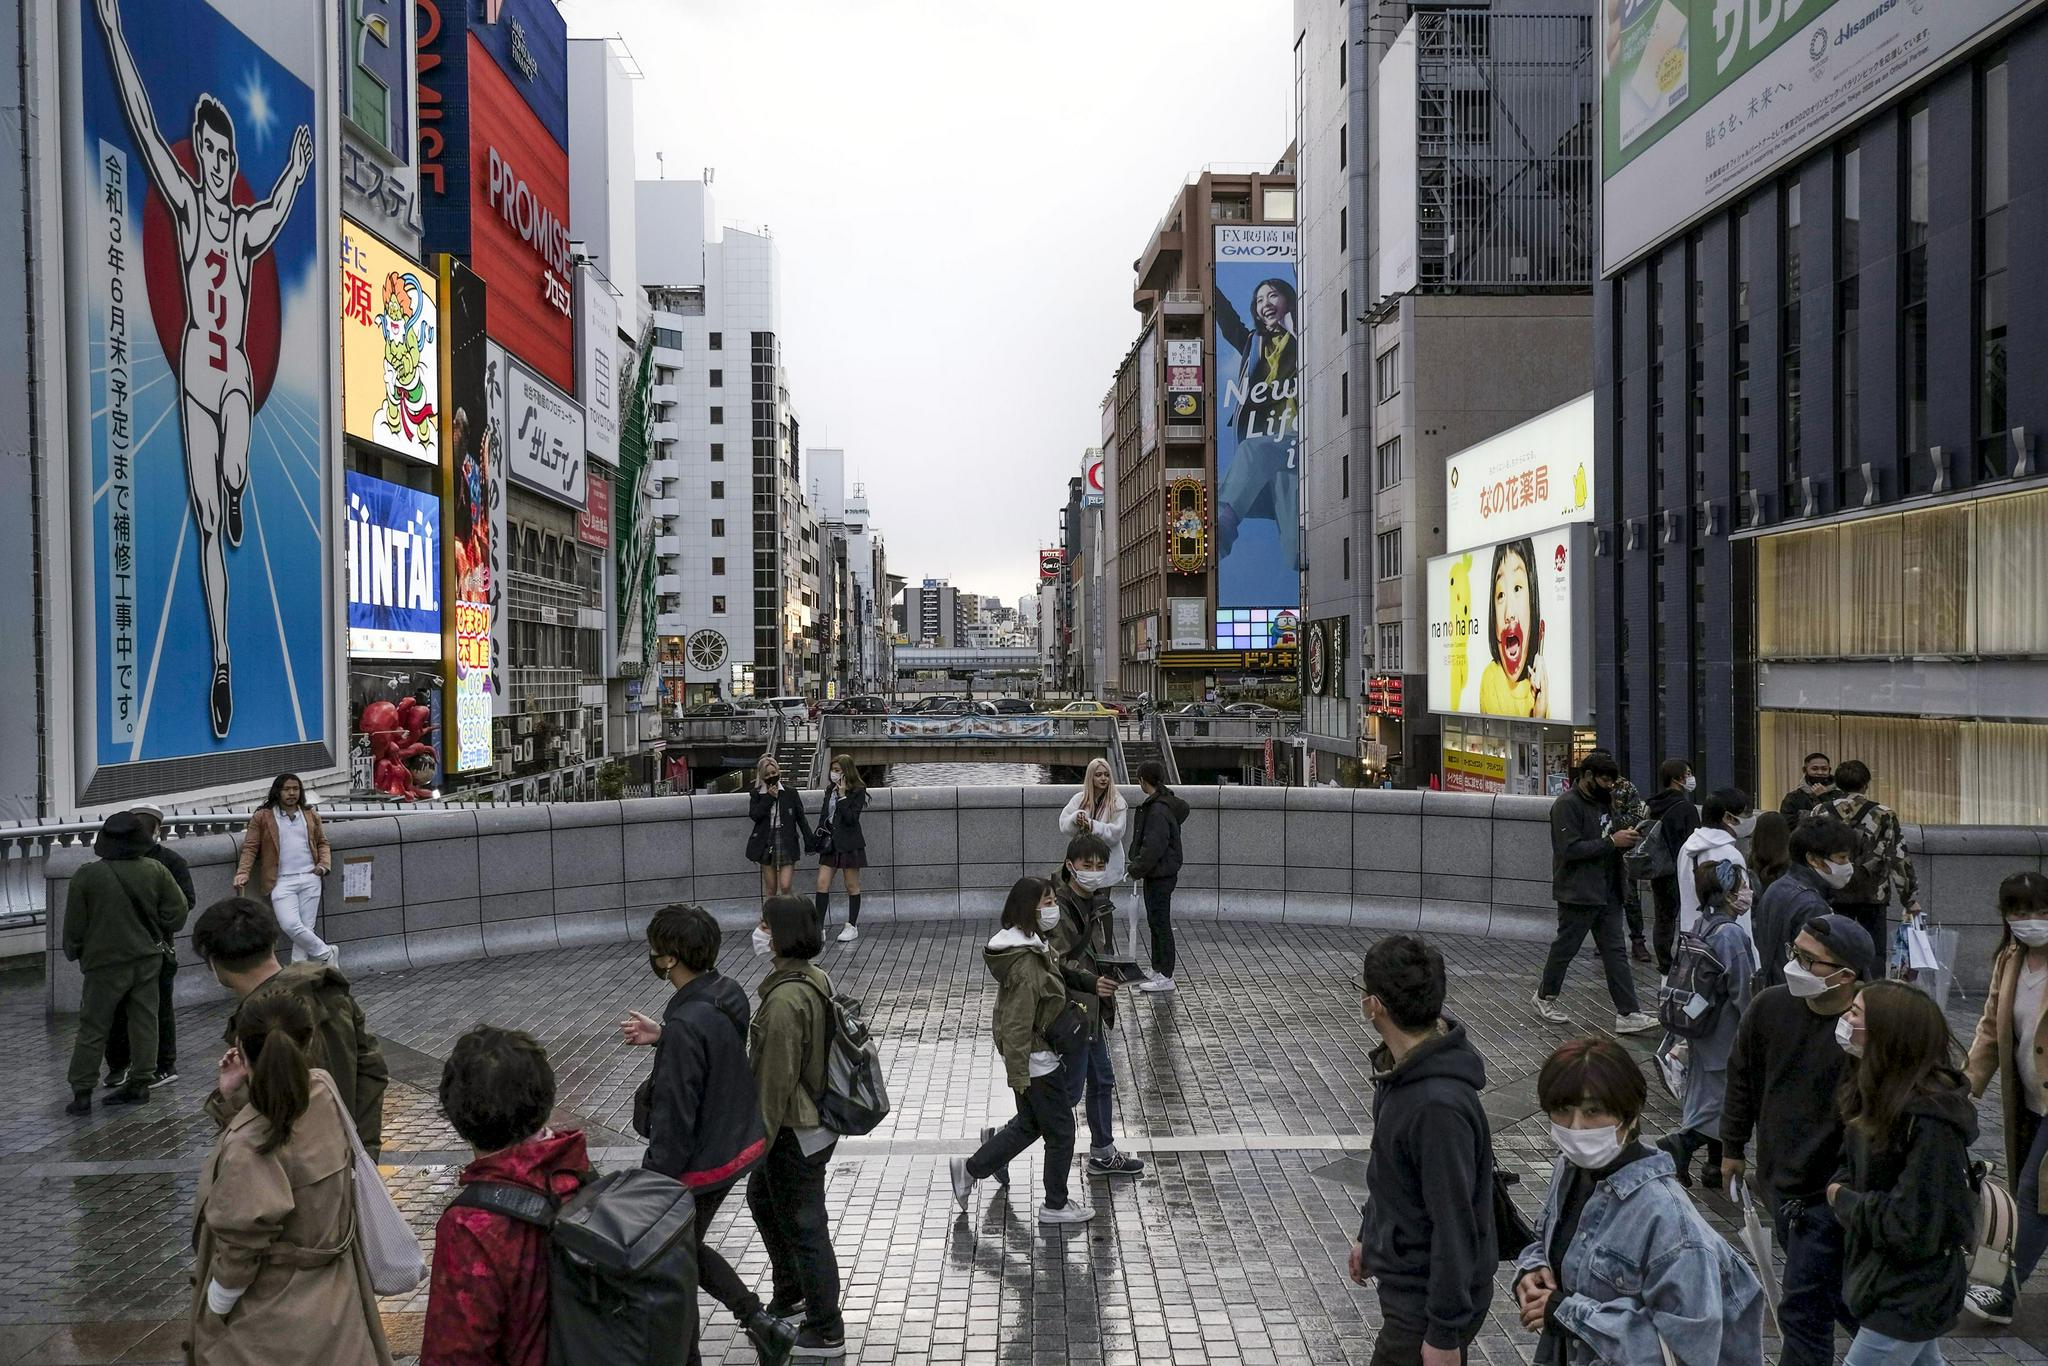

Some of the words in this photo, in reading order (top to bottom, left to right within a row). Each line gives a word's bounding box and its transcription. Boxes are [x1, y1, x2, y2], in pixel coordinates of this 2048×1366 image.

[512, 15, 526, 44] SMBC
[1712, 0, 1804, 76] サロ
[512, 30, 538, 77] CONSUMER
[512, 45, 534, 84] FINANCE
[489, 145, 571, 284] PROMISE
[204, 248, 230, 373] グリコ
[344, 269, 373, 327] 源
[544, 269, 572, 319] プロミス
[1223, 377, 1298, 408] New
[1480, 464, 1550, 519] なの花薬局
[455, 603, 491, 637] ひまわり
[1431, 622, 1441, 638] na
[1442, 621, 1453, 637] no
[1455, 614, 1466, 636] ha
[1468, 618, 1479, 635] na
[457, 635, 490, 669] 不動産
[467, 672, 482, 696] 06
[462, 721, 488, 745] 6304
